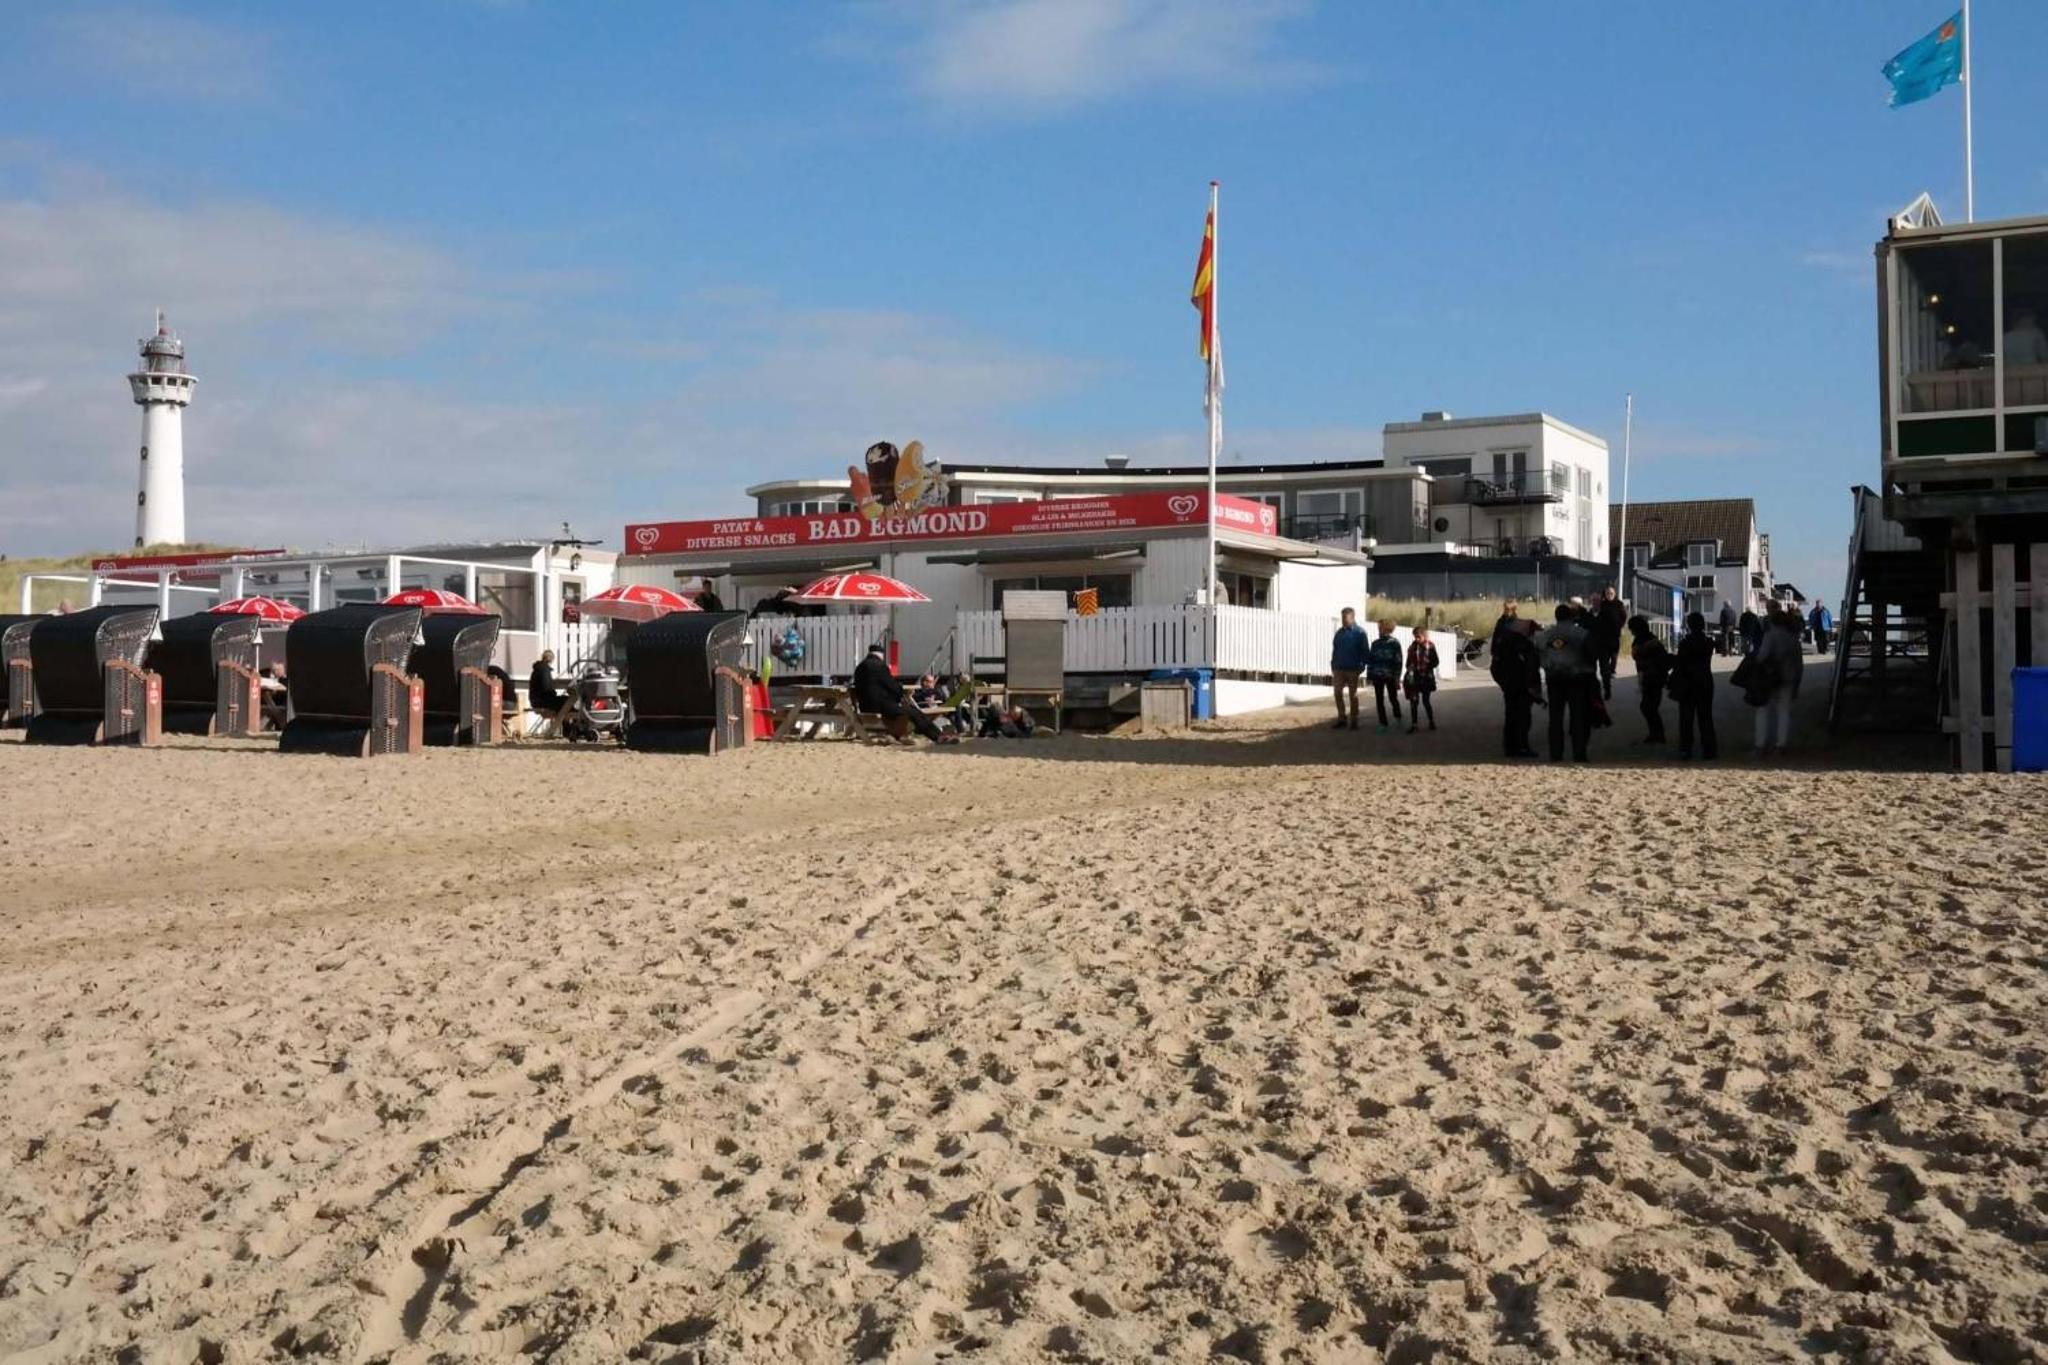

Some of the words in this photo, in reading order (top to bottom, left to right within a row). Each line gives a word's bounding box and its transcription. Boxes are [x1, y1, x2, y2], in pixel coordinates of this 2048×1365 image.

[713, 522, 751, 533] PATAT
[754, 521, 765, 532] &
[808, 519, 861, 540] BAD
[869, 511, 986, 536] EGMOND
[687, 537, 741, 548] DIVERSE
[745, 533, 796, 545] SNACKS
